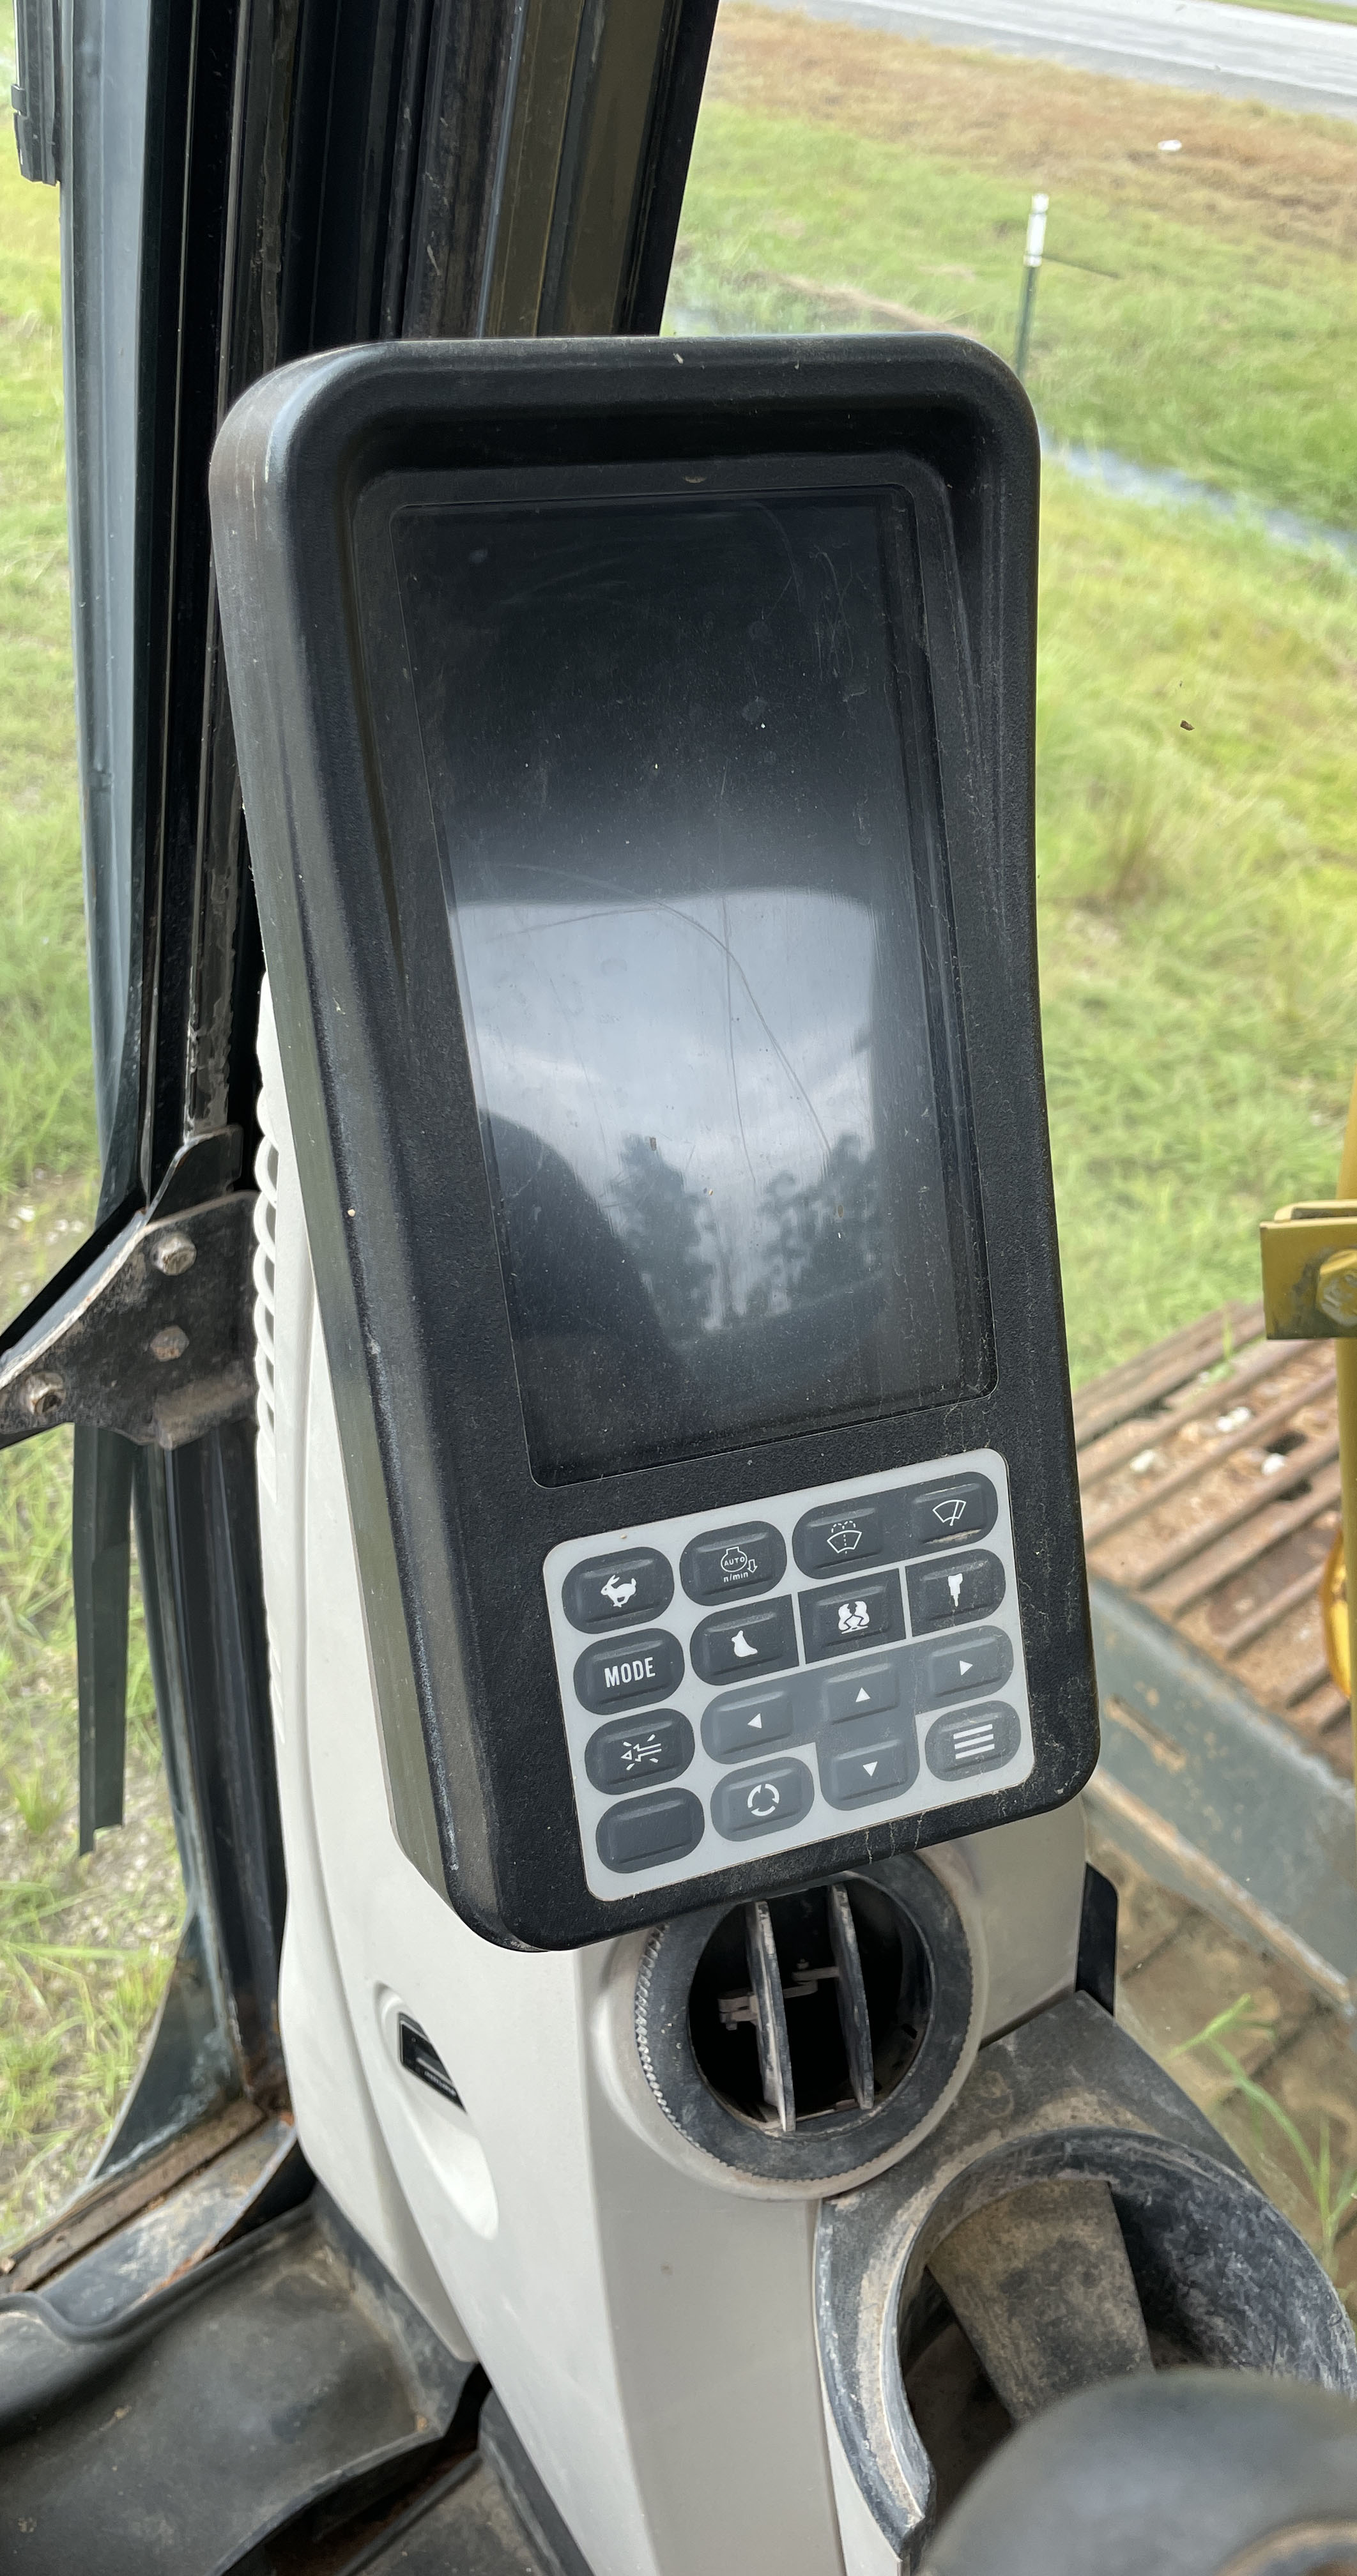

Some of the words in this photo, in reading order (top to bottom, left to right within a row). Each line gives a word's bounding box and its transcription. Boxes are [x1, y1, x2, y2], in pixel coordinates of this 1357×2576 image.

[724, 1556, 745, 1567] AUTO
[723, 1572, 749, 1583] n/min
[604, 1657, 656, 1688] MODE
